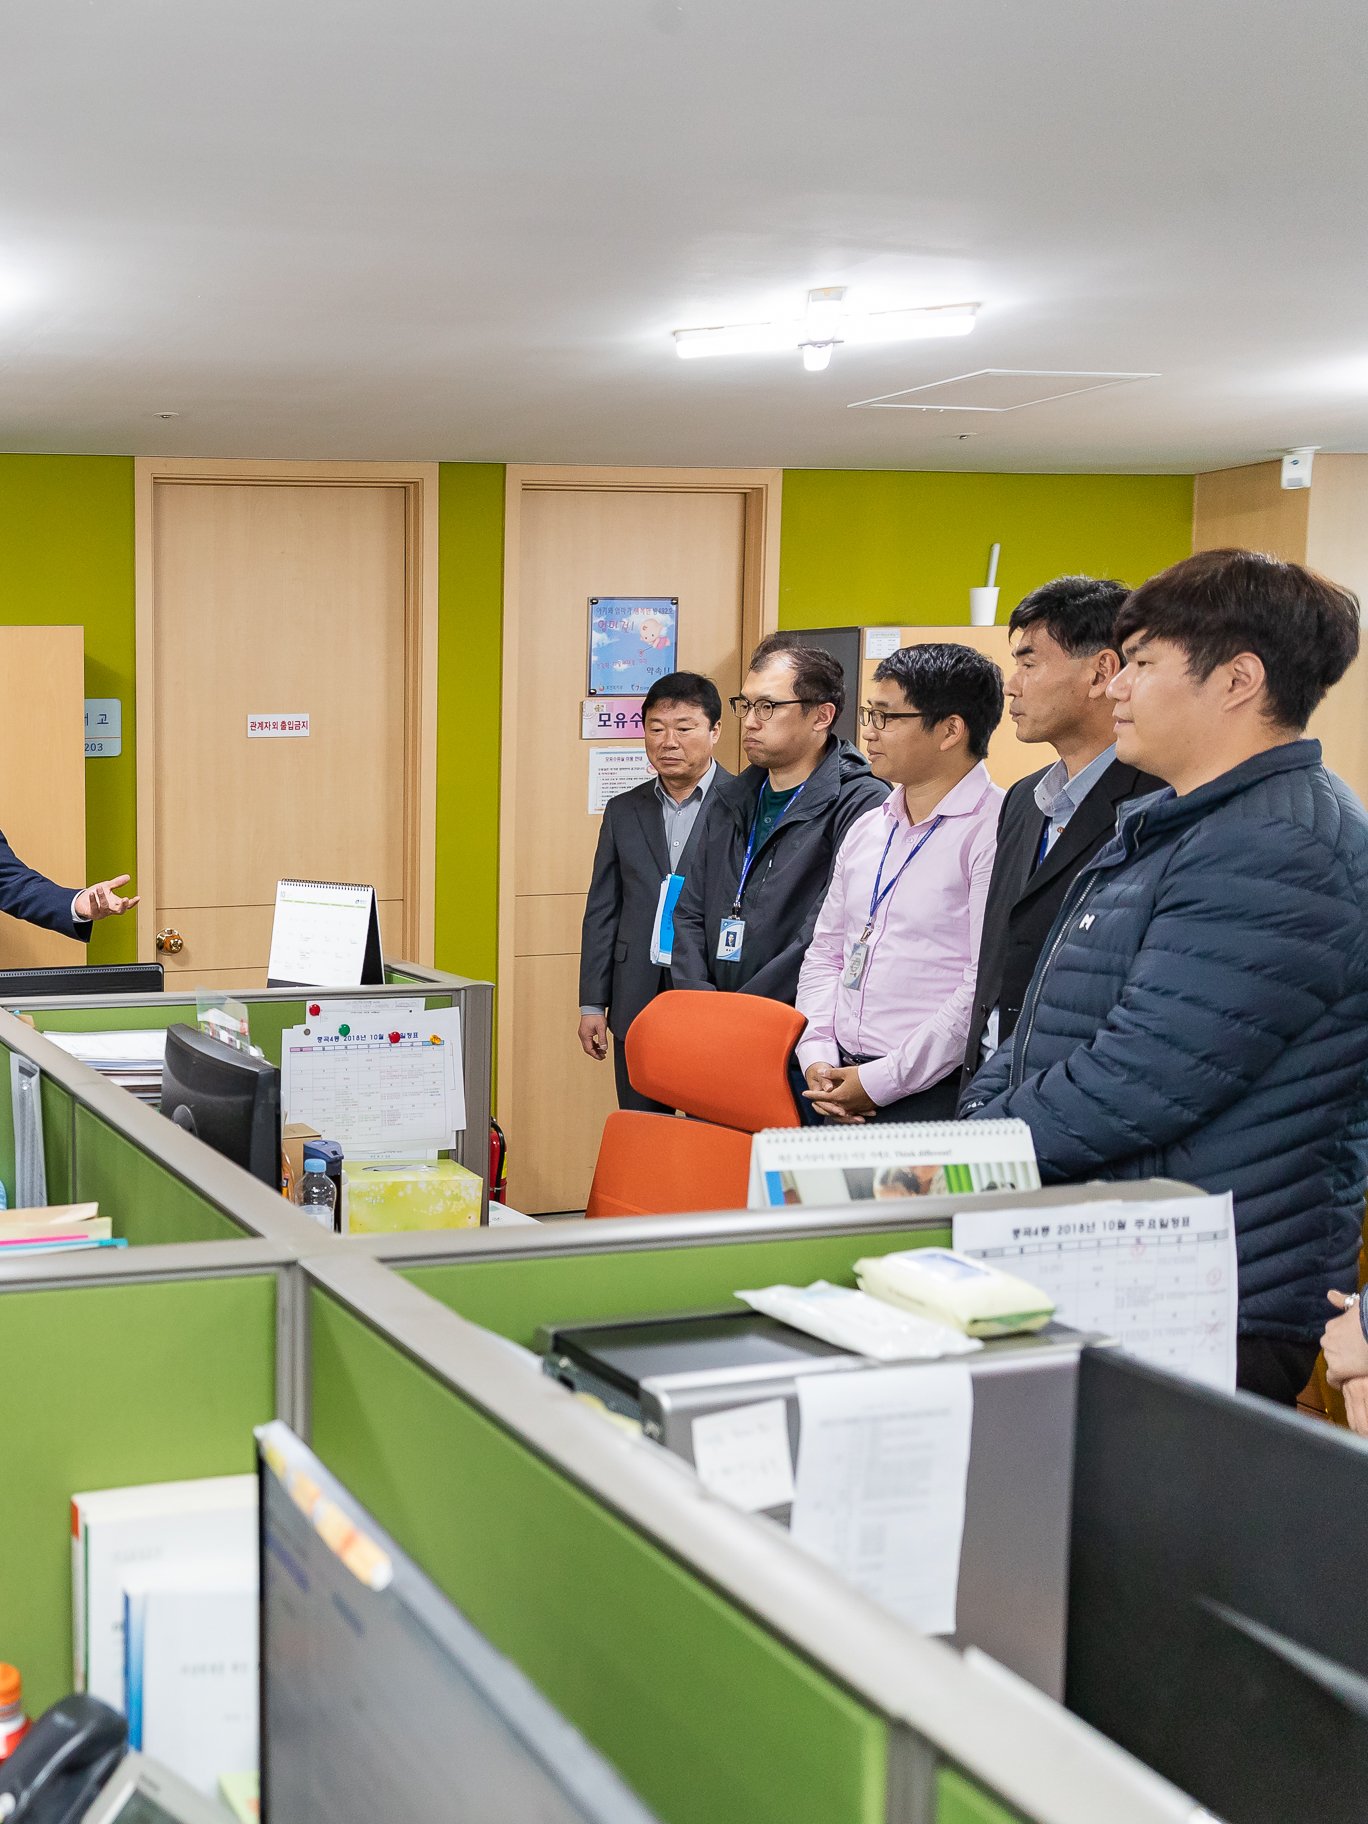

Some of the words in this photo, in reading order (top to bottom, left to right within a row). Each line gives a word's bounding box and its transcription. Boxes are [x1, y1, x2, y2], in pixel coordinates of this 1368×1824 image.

[596, 606, 614, 615] 아기와
[614, 606, 632, 615] 엄마가
[634, 607, 652, 615] 행복한
[598, 620, 618, 632] 엄마
[249, 720, 279, 731] 관계자외
[280, 720, 309, 731] 출입금지
[343, 1034, 366, 1042] 2018년
[894, 1149, 916, 1158] Think
[1057, 1221, 1096, 1236] 2018년
[1102, 1220, 1127, 1231] 10월
[1135, 1216, 1190, 1230] 주요일정표
